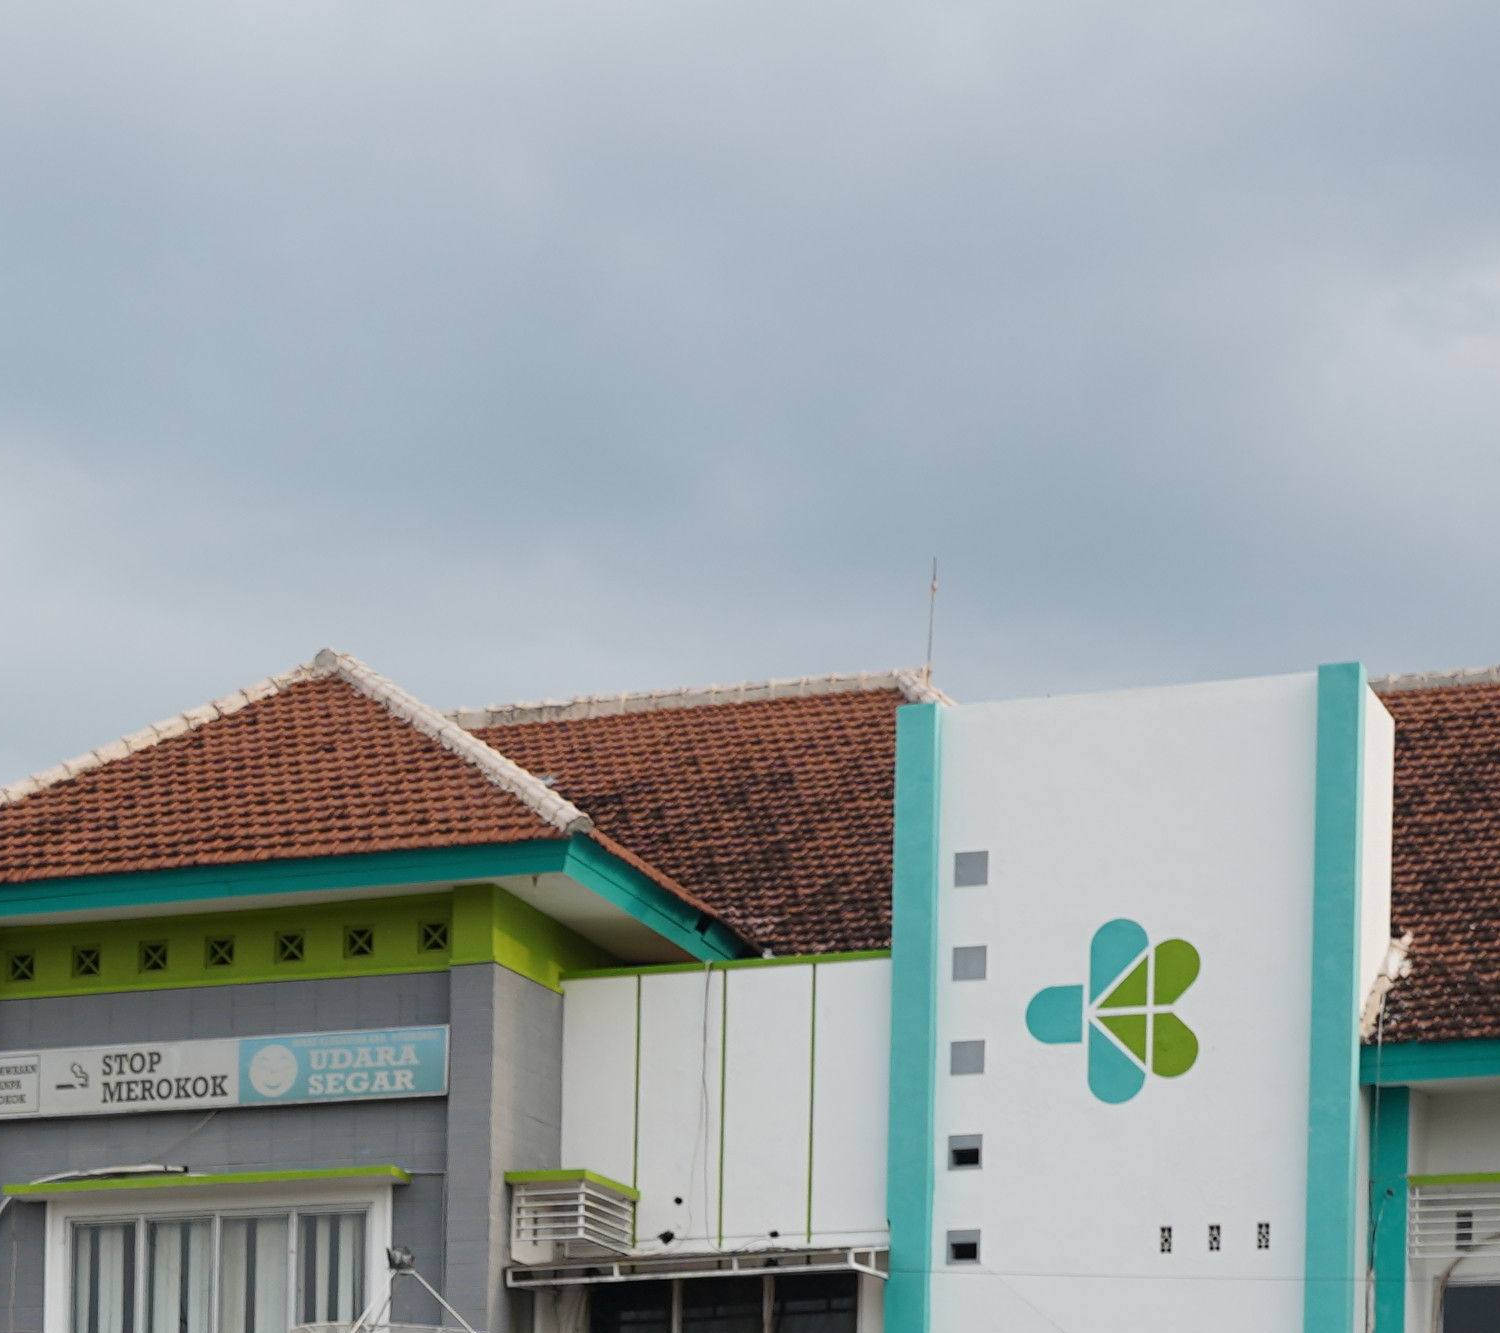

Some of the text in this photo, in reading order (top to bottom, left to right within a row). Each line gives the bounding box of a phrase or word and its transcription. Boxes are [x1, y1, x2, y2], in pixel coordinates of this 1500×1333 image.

[102, 1051, 162, 1076] STOP
[309, 1044, 420, 1070] UDARA
[102, 1075, 229, 1104] MEROKOK
[308, 1070, 416, 1095] SEGAR
